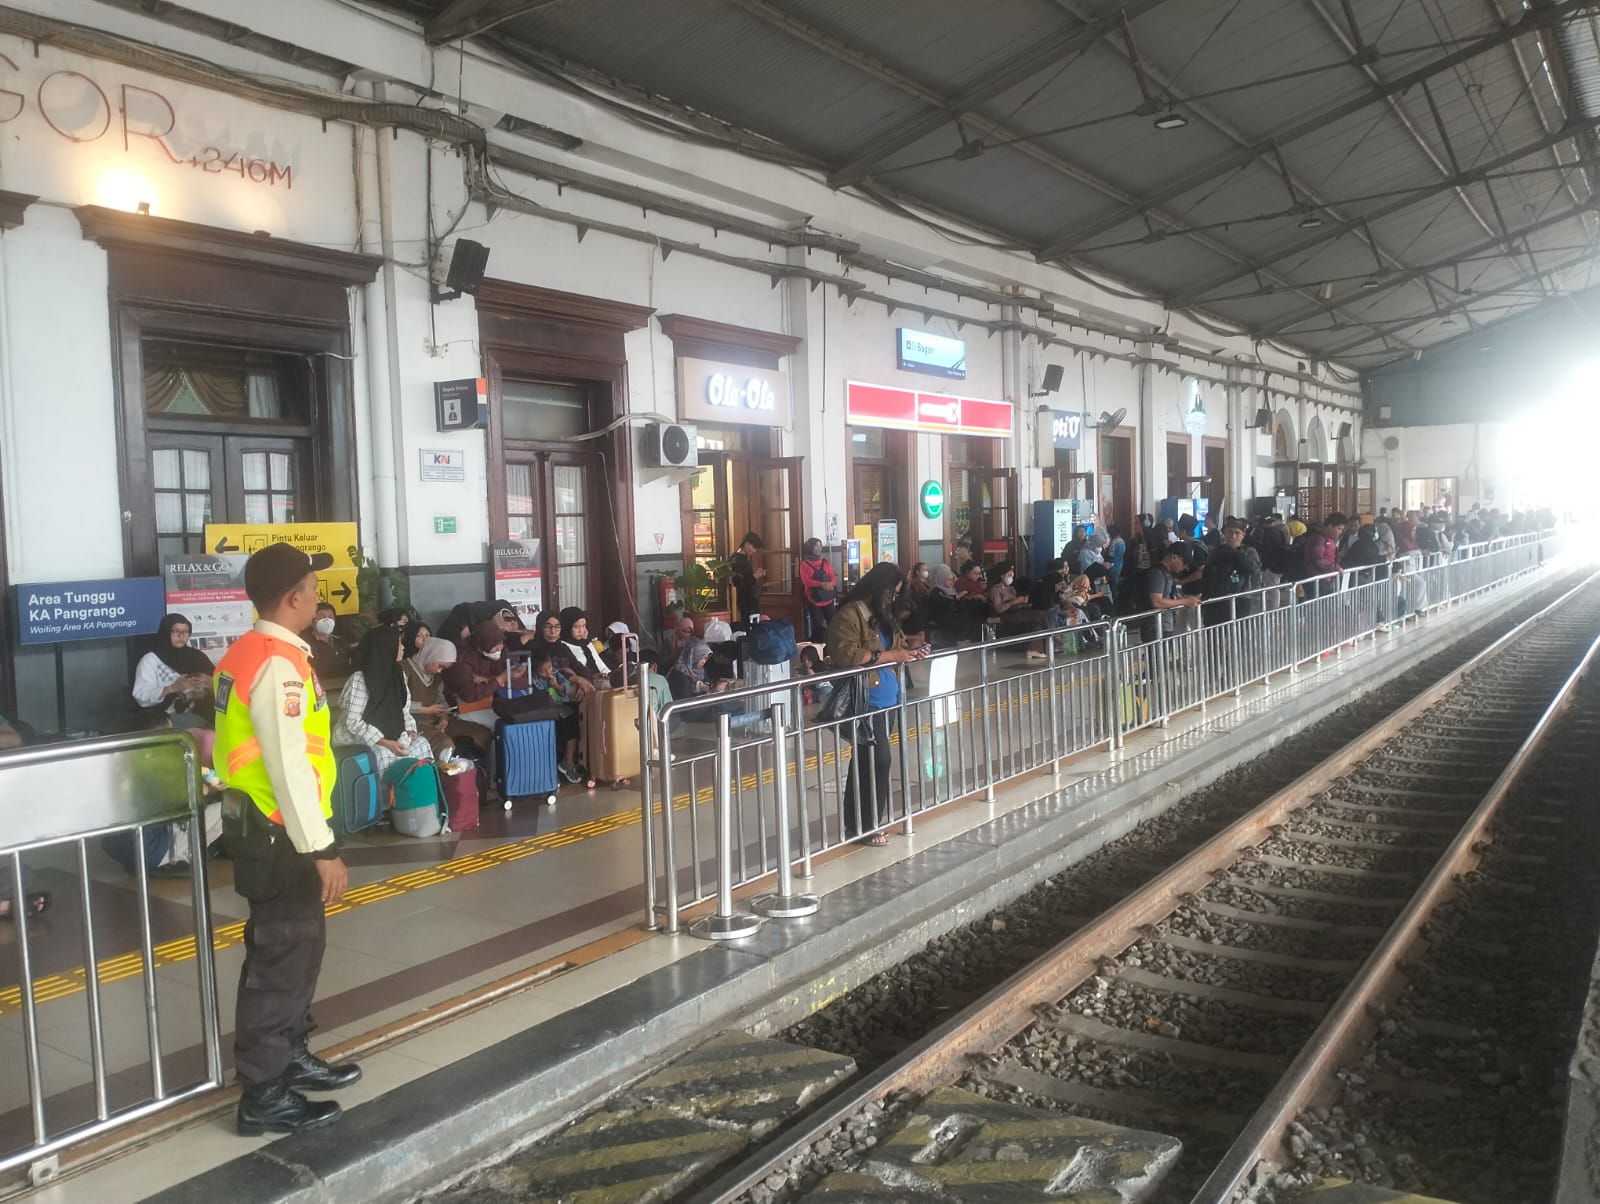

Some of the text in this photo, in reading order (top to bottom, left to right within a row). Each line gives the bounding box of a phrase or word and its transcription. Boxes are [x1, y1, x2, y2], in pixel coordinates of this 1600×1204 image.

[271, 534, 292, 542] Pintu
[296, 545, 326, 553] ngrango
[28, 592, 115, 606] Area Tunggu
[29, 606, 126, 621] KA Pangrango
[30, 619, 137, 634] Waiting Area KA Pangrango
